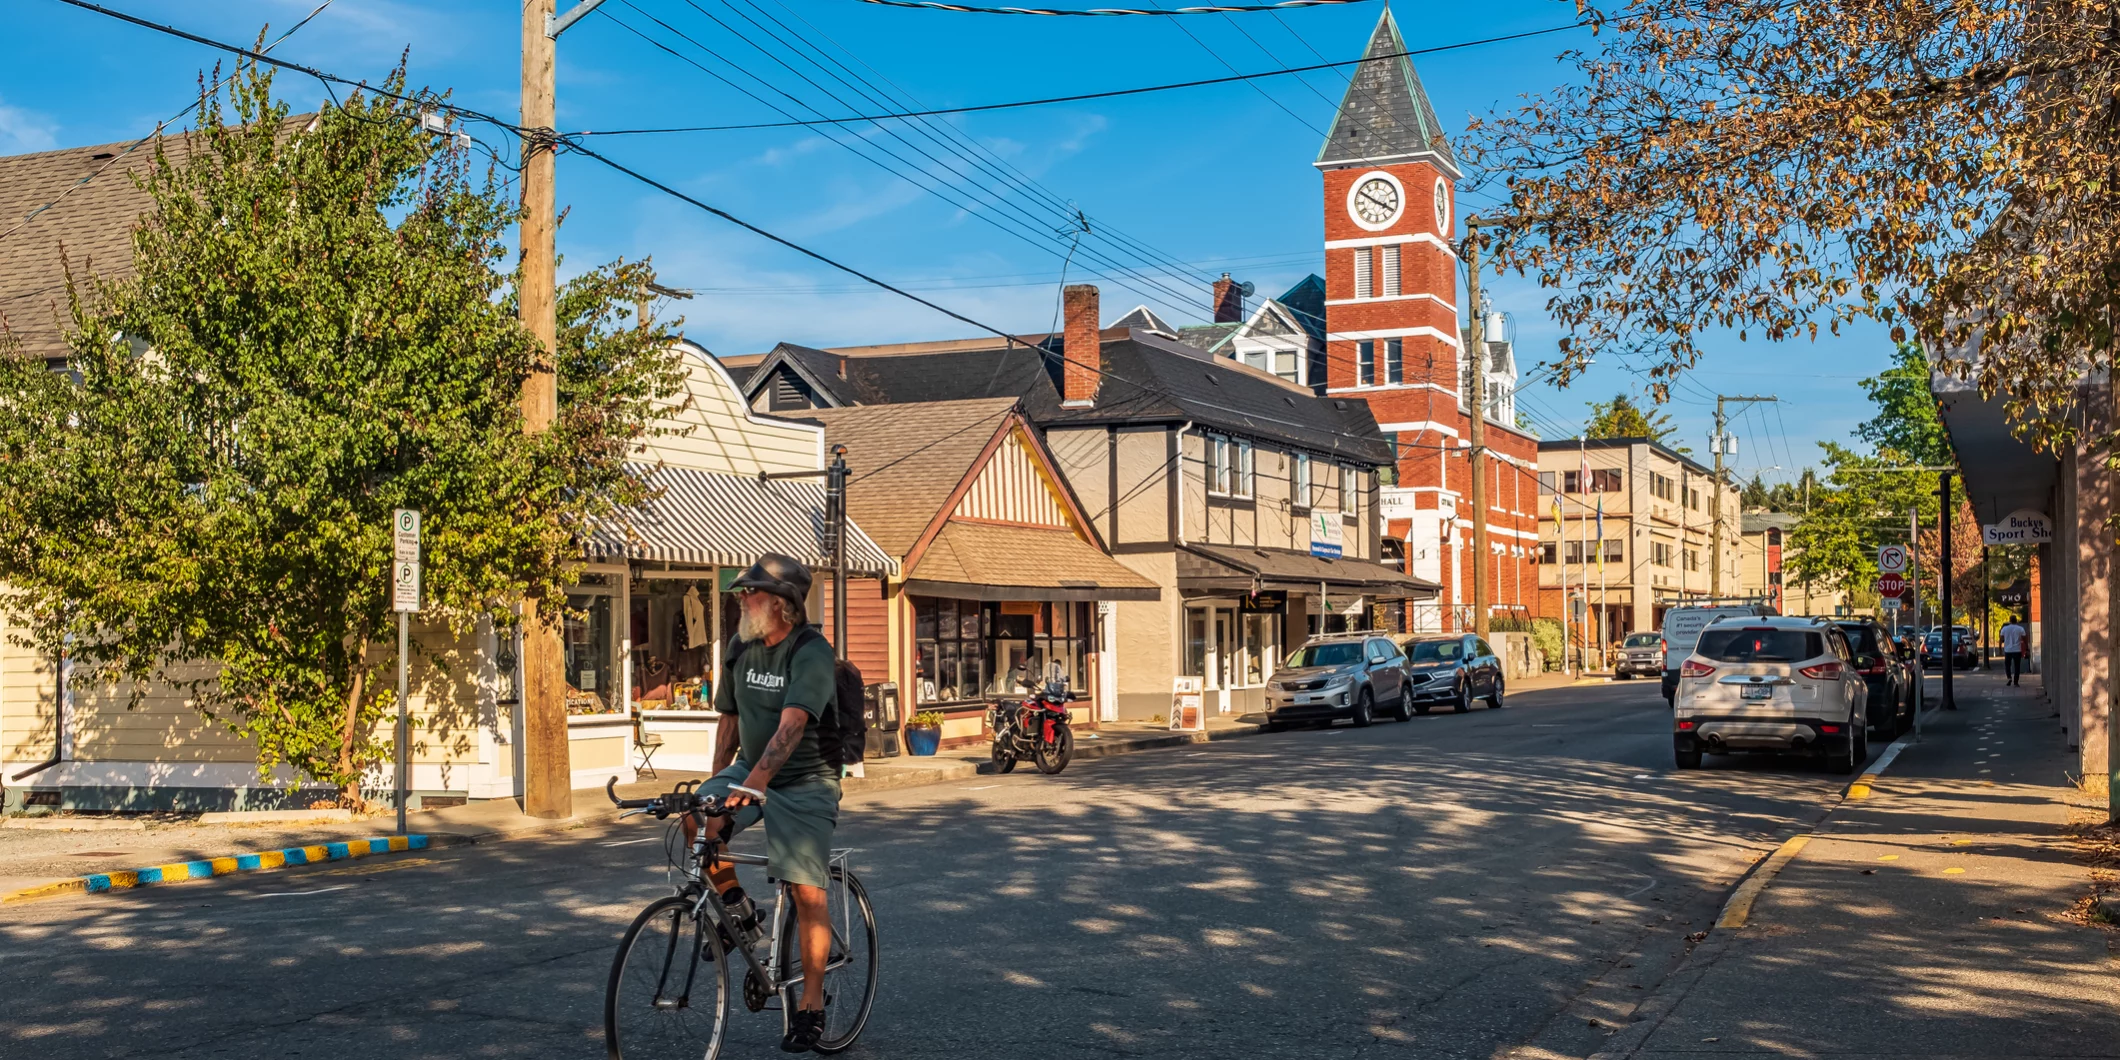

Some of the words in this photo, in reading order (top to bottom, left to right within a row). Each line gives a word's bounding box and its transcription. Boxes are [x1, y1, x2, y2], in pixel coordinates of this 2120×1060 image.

[1381, 498, 1404, 506] HALL
[2010, 516, 2044, 528] Buckys
[1989, 528, 2025, 541] Sport
[1879, 580, 1904, 590] STOP
